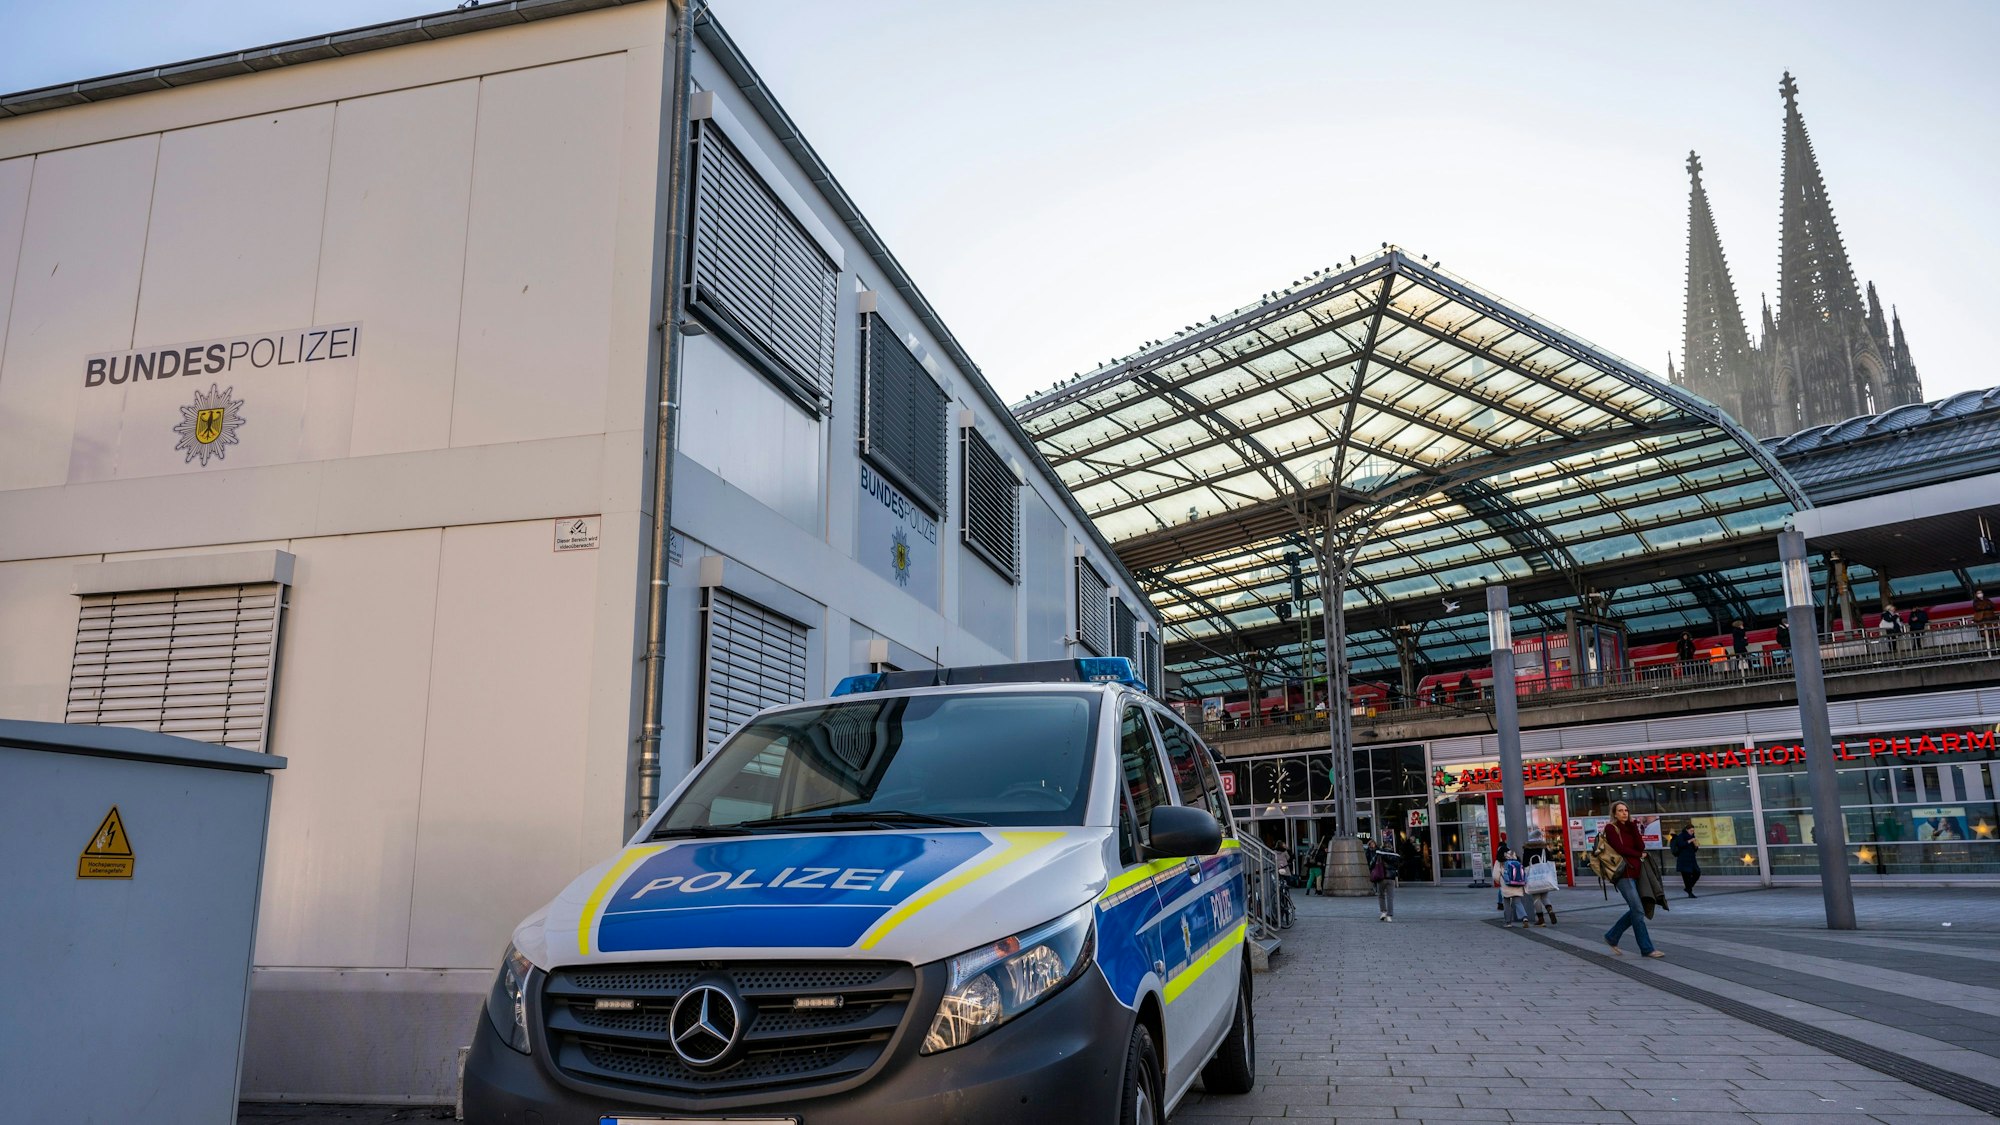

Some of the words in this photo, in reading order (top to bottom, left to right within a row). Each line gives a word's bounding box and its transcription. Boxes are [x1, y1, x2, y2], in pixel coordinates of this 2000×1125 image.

[85, 327, 358, 388] BUNDESPOLIZEI
[861, 464, 937, 546] BUNDESPOLIZEI
[1459, 761, 1579, 785] APOHEKE
[1619, 741, 1856, 775] INTERNATIONL
[1869, 729, 1996, 760] PHARM
[630, 867, 905, 900] POLIZEI
[1210, 888, 1233, 932] POLIZEI
